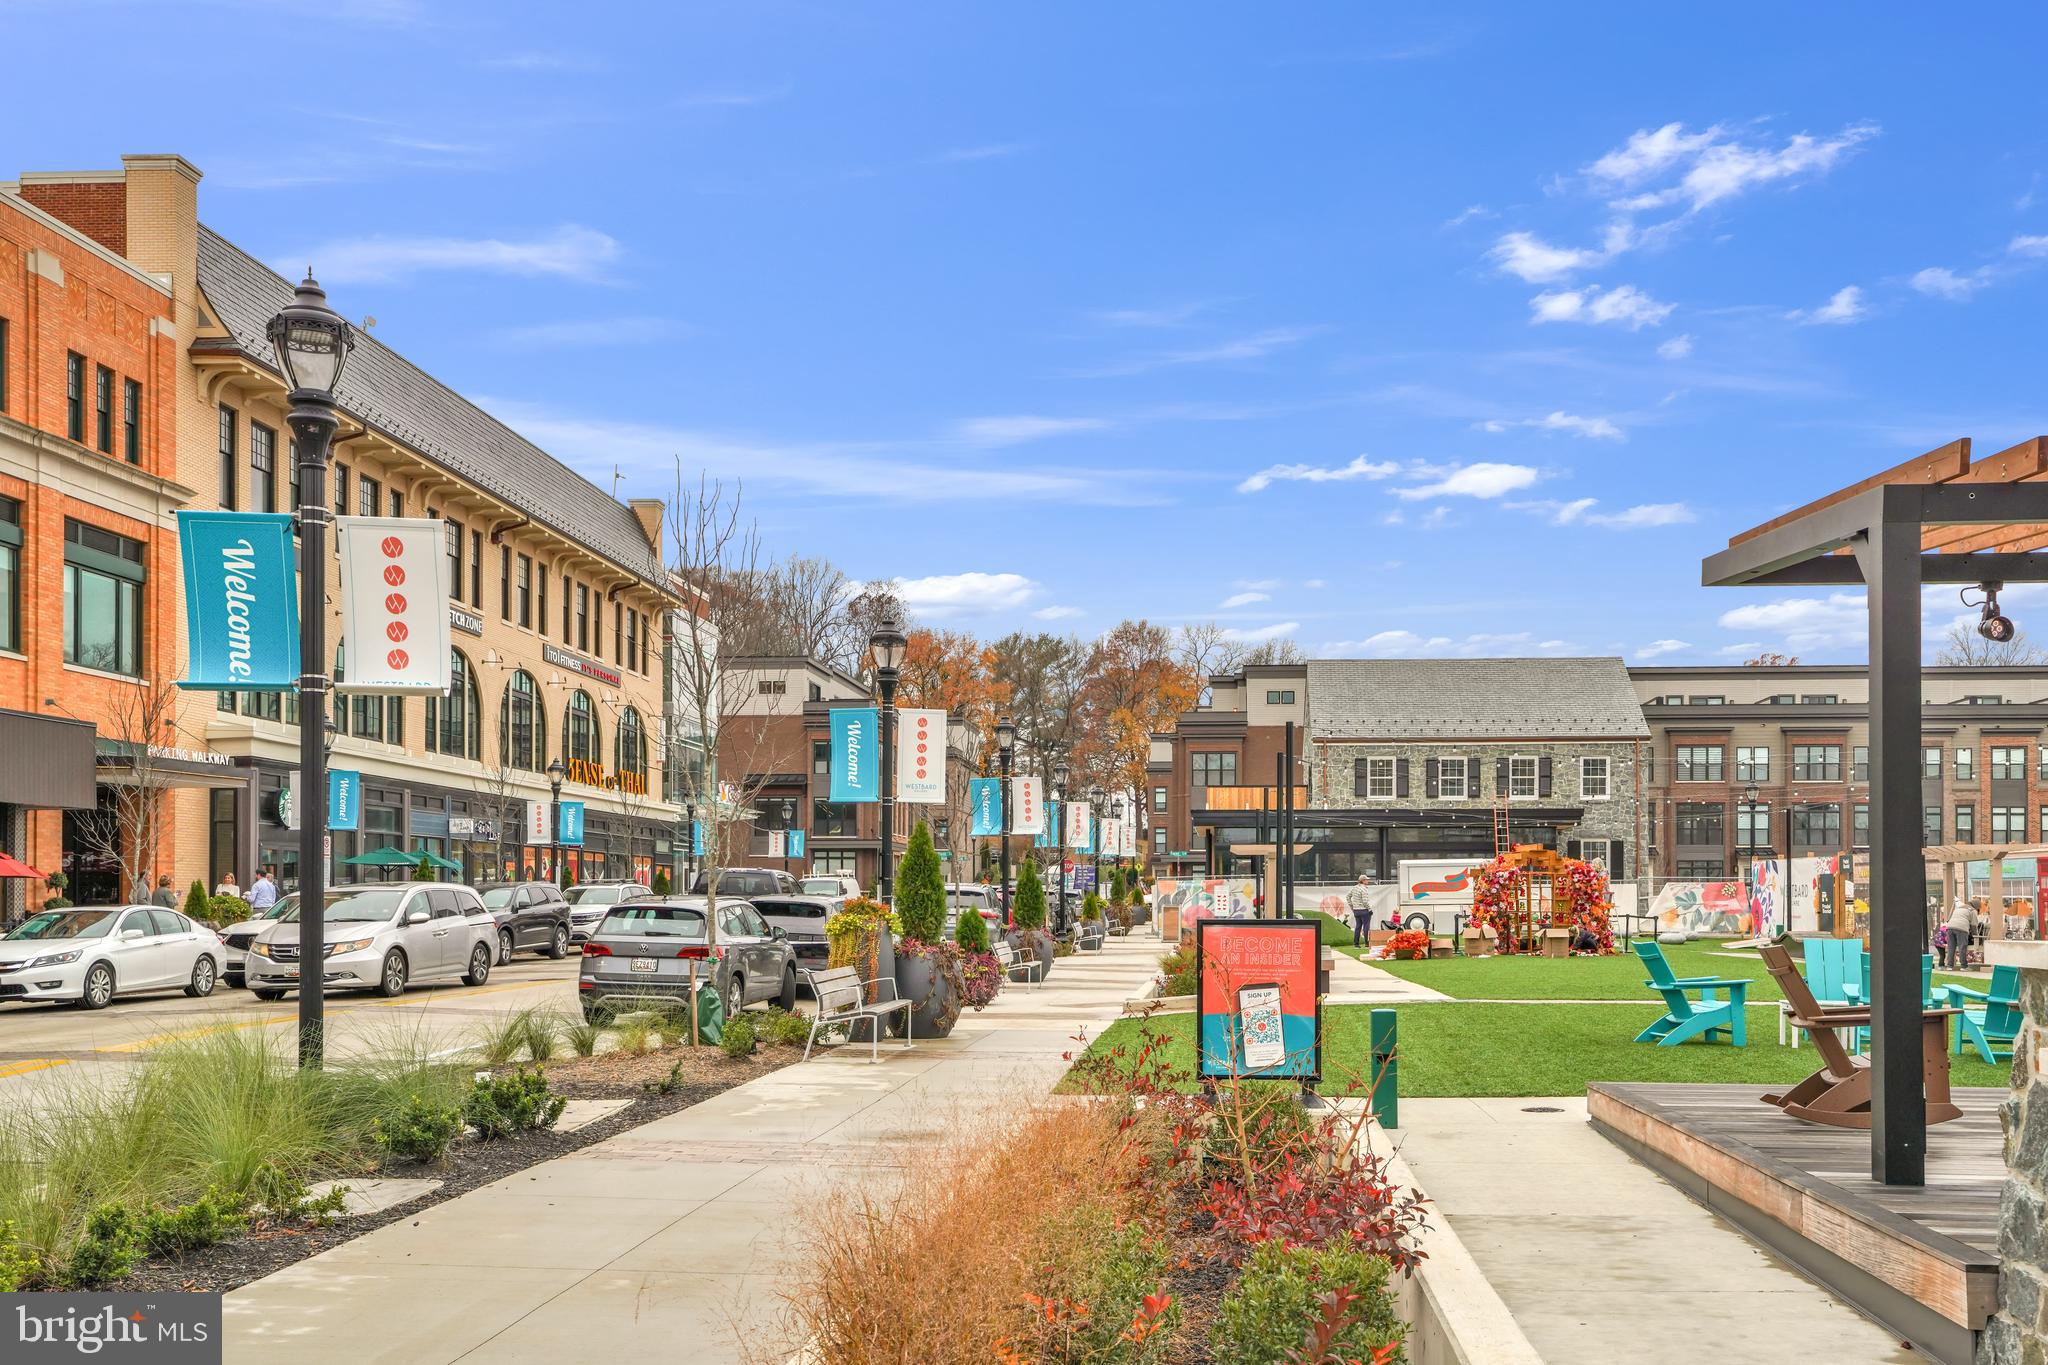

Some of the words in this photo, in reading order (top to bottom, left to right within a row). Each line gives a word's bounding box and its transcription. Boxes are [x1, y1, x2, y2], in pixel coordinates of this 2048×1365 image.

[222, 539, 257, 683] Welcome!
[465, 615, 482, 633] ZONE
[560, 654, 581, 671] FITNESS
[147, 743, 188, 761] PARKING
[191, 750, 230, 766] WALKWAY
[847, 720, 862, 788] Welcome!
[568, 757, 605, 789] SENSE
[618, 768, 646, 796] THAI
[338, 777, 350, 822] Welcome!
[981, 785, 992, 830] Welcome!
[567, 806, 577, 840] Welcome!
[1220, 935, 1303, 954] BECOME
[1220, 952, 1241, 965] AN
[1244, 953, 1302, 966] INSIDER
